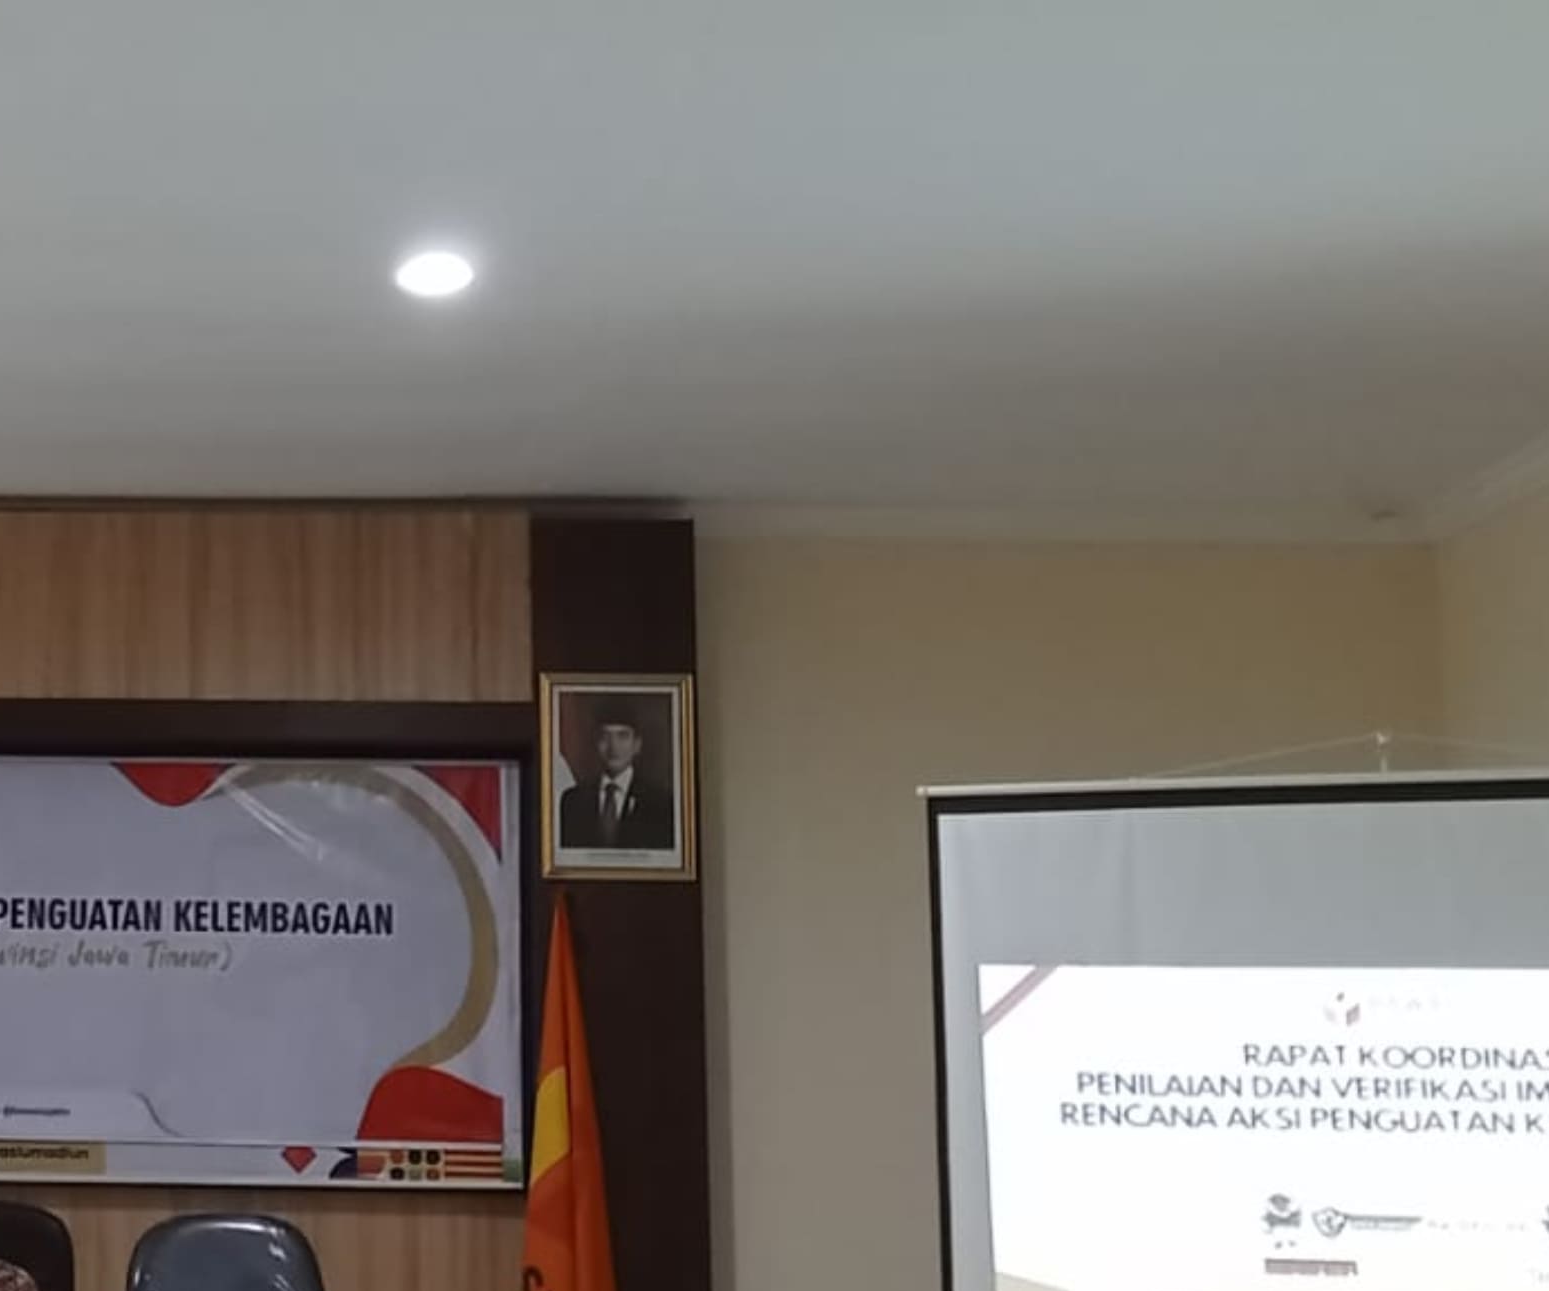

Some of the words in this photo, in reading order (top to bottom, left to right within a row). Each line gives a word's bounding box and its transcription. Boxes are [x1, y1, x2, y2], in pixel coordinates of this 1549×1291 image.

[173, 900, 394, 935] KELEMBAGAAN
[67, 939, 130, 968] Jawa
[143, 939, 233, 971] Timur)
[1243, 1043, 1346, 1068] RAPAT
[1077, 1071, 1242, 1099] PENILAIAN
[1252, 1075, 1322, 1099] DAN
[1331, 1077, 1507, 1103] VERIFIKASI
[1059, 1102, 1218, 1129] RENCANA
[1227, 1106, 1301, 1130] AKSI
[1310, 1108, 1515, 1134] PENGUATAN
